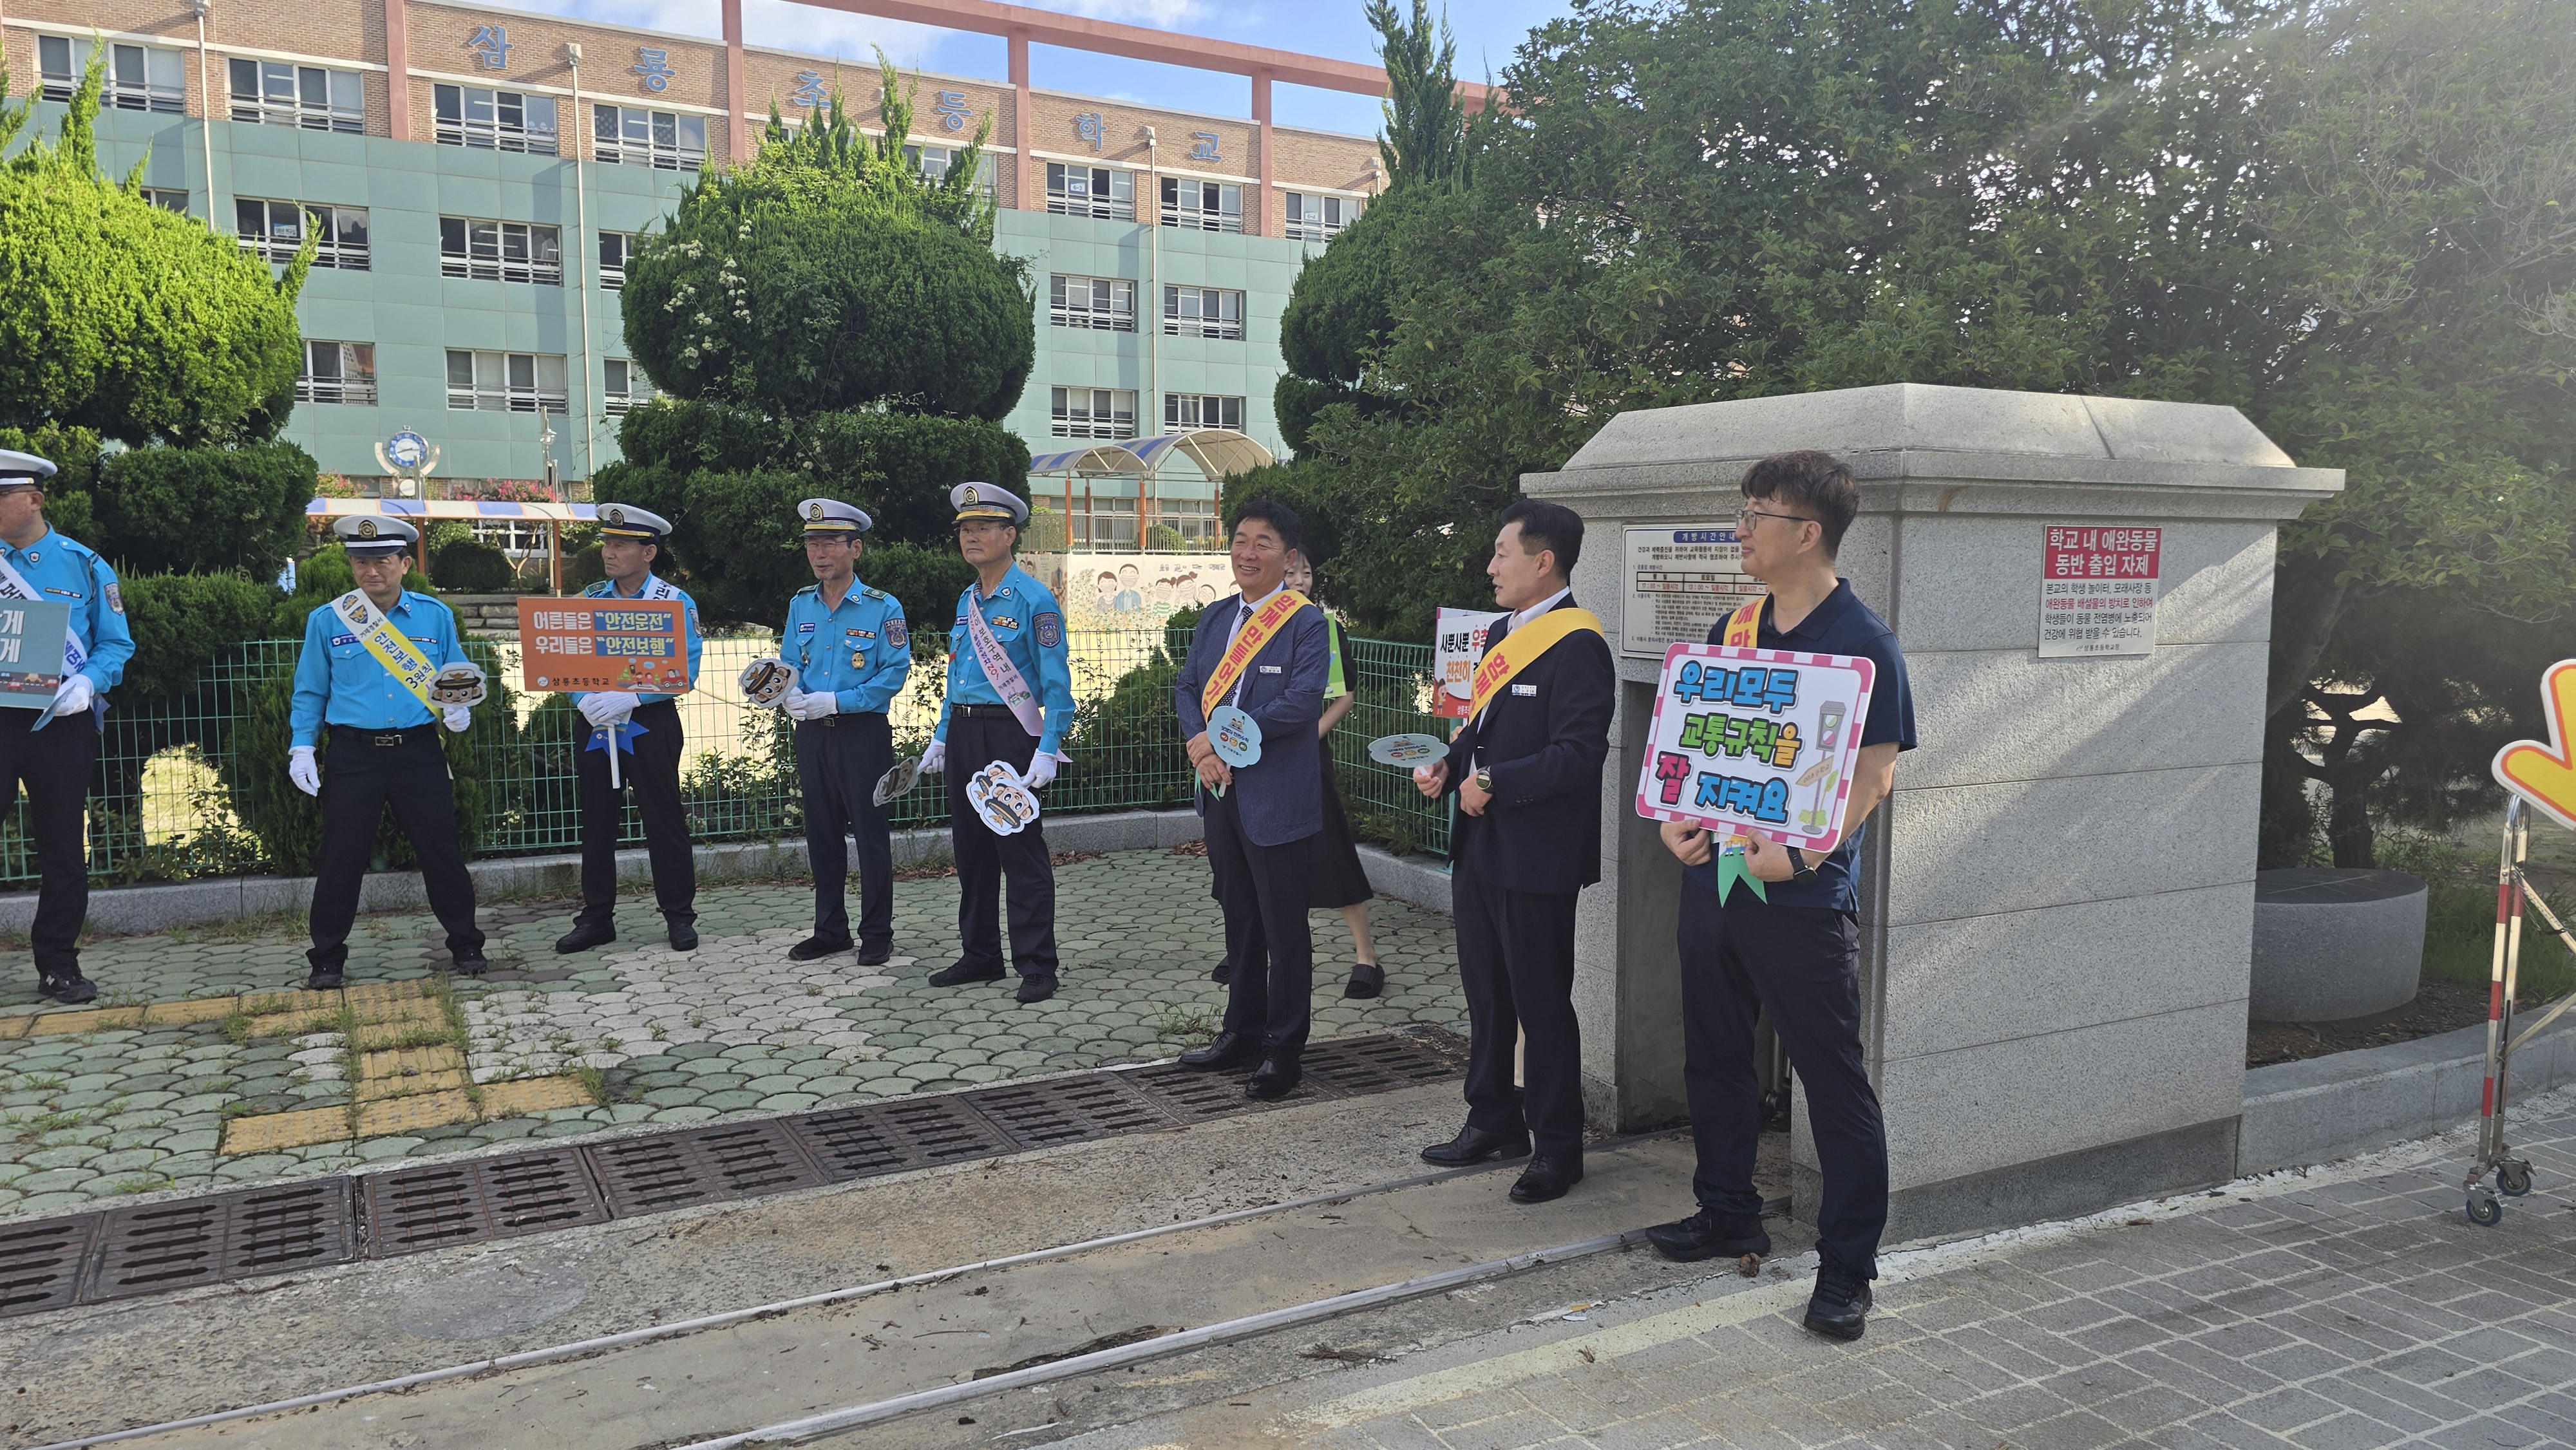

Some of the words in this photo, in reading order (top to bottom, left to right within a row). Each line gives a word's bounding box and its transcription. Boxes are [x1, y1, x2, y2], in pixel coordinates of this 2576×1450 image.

[2050, 529, 2079, 551] 학교
[2083, 529, 2097, 551] 내
[2101, 529, 2158, 552] 애완동물
[2055, 554, 2085, 576] 동반
[2088, 554, 2117, 576] 출입
[2121, 554, 2149, 576] 자제
[2046, 583, 2069, 595] 본교의
[2071, 583, 2086, 594] 학생
[2088, 583, 2112, 595] 놀이터,
[2114, 583, 2143, 594] 모래사장
[2144, 583, 2152, 594] 등
[1258, 594, 1298, 630] 함께
[2046, 598, 2075, 610] 애완동물
[2078, 598, 2106, 609] 배설물의
[2108, 598, 2130, 609] 방치로
[2132, 597, 2153, 609] 인하여
[533, 611, 592, 630] 어른들은
[2045, 613, 2074, 625] 학생들이
[2076, 613, 2091, 625] 동물
[2093, 612, 2121, 625] 전염병에
[2123, 612, 2152, 623] 노출되어
[1440, 632, 1470, 654] 사뿐사뿐
[2044, 628, 2065, 640] 건강에
[2068, 628, 2083, 639] 위협
[2085, 627, 2100, 639] 받을
[2101, 626, 2110, 638] 수
[2112, 626, 2142, 638] 있습니다.
[535, 636, 592, 655] 우리들은
[1446, 659, 1471, 683] 천천히
[1475, 652, 1510, 700] 함께
[1674, 660, 1799, 715] 우리모두
[1678, 712, 1803, 768] 교통규칙을
[1655, 750, 1692, 805] 잘
[1694, 770, 1790, 824] 지켜요
